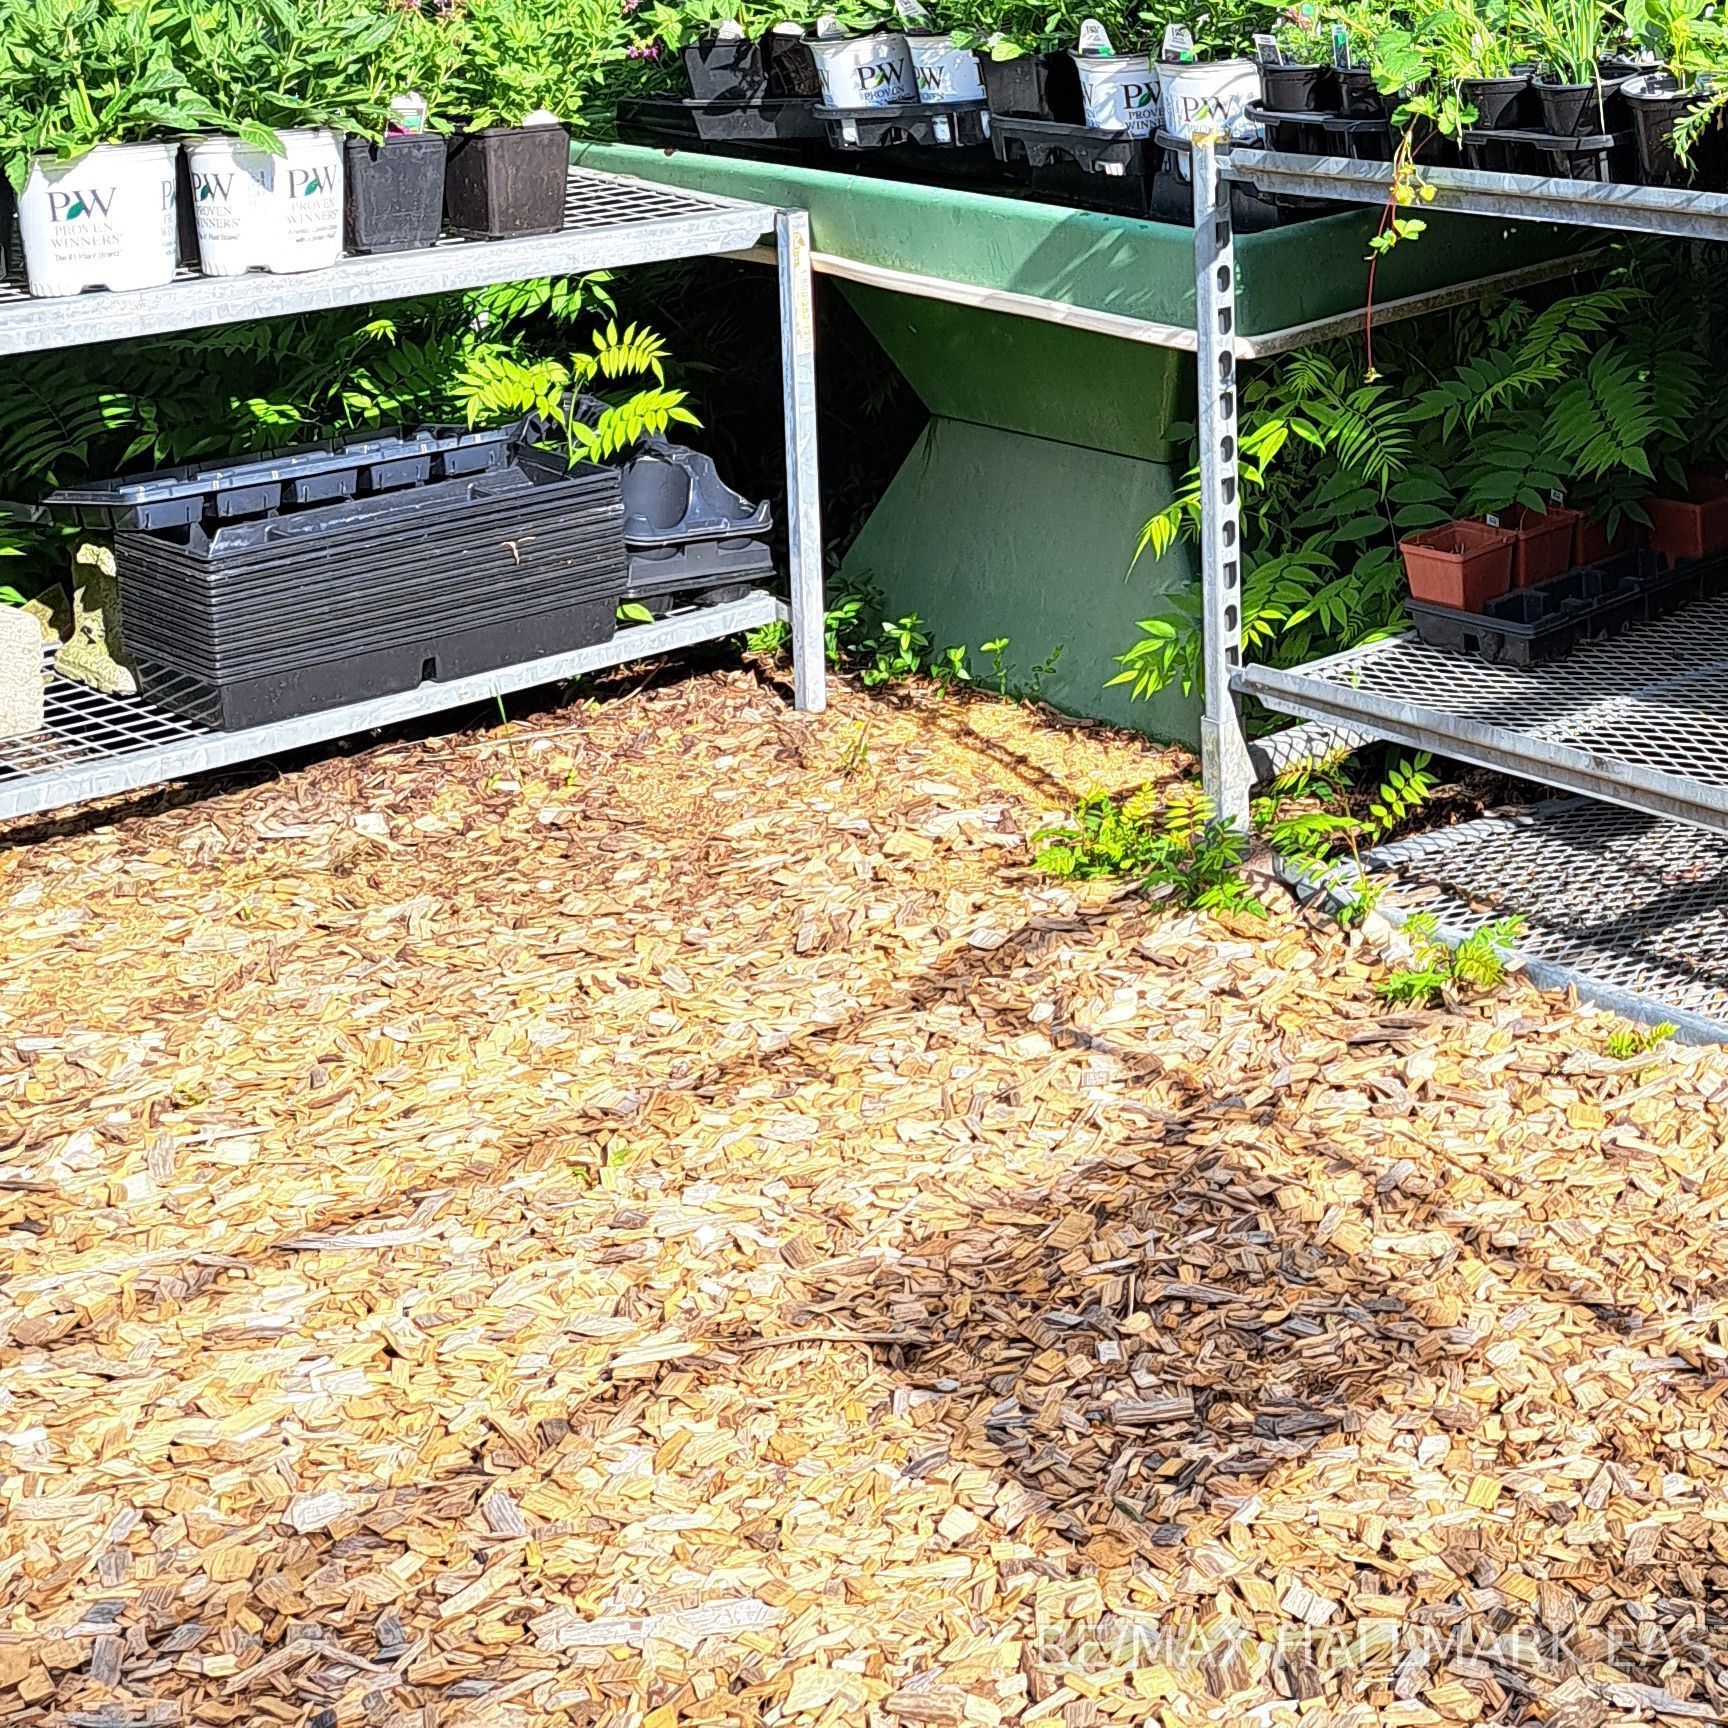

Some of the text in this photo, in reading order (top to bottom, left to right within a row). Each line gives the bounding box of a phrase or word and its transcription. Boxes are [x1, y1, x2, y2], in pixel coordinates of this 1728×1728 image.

[1128, 109, 1164, 121] PROVE
[1126, 118, 1164, 131] WINNE
[291, 198, 336, 212] PROVEN
[55, 222, 113, 237] PROVEN
[50, 234, 121, 249] WINNERS
